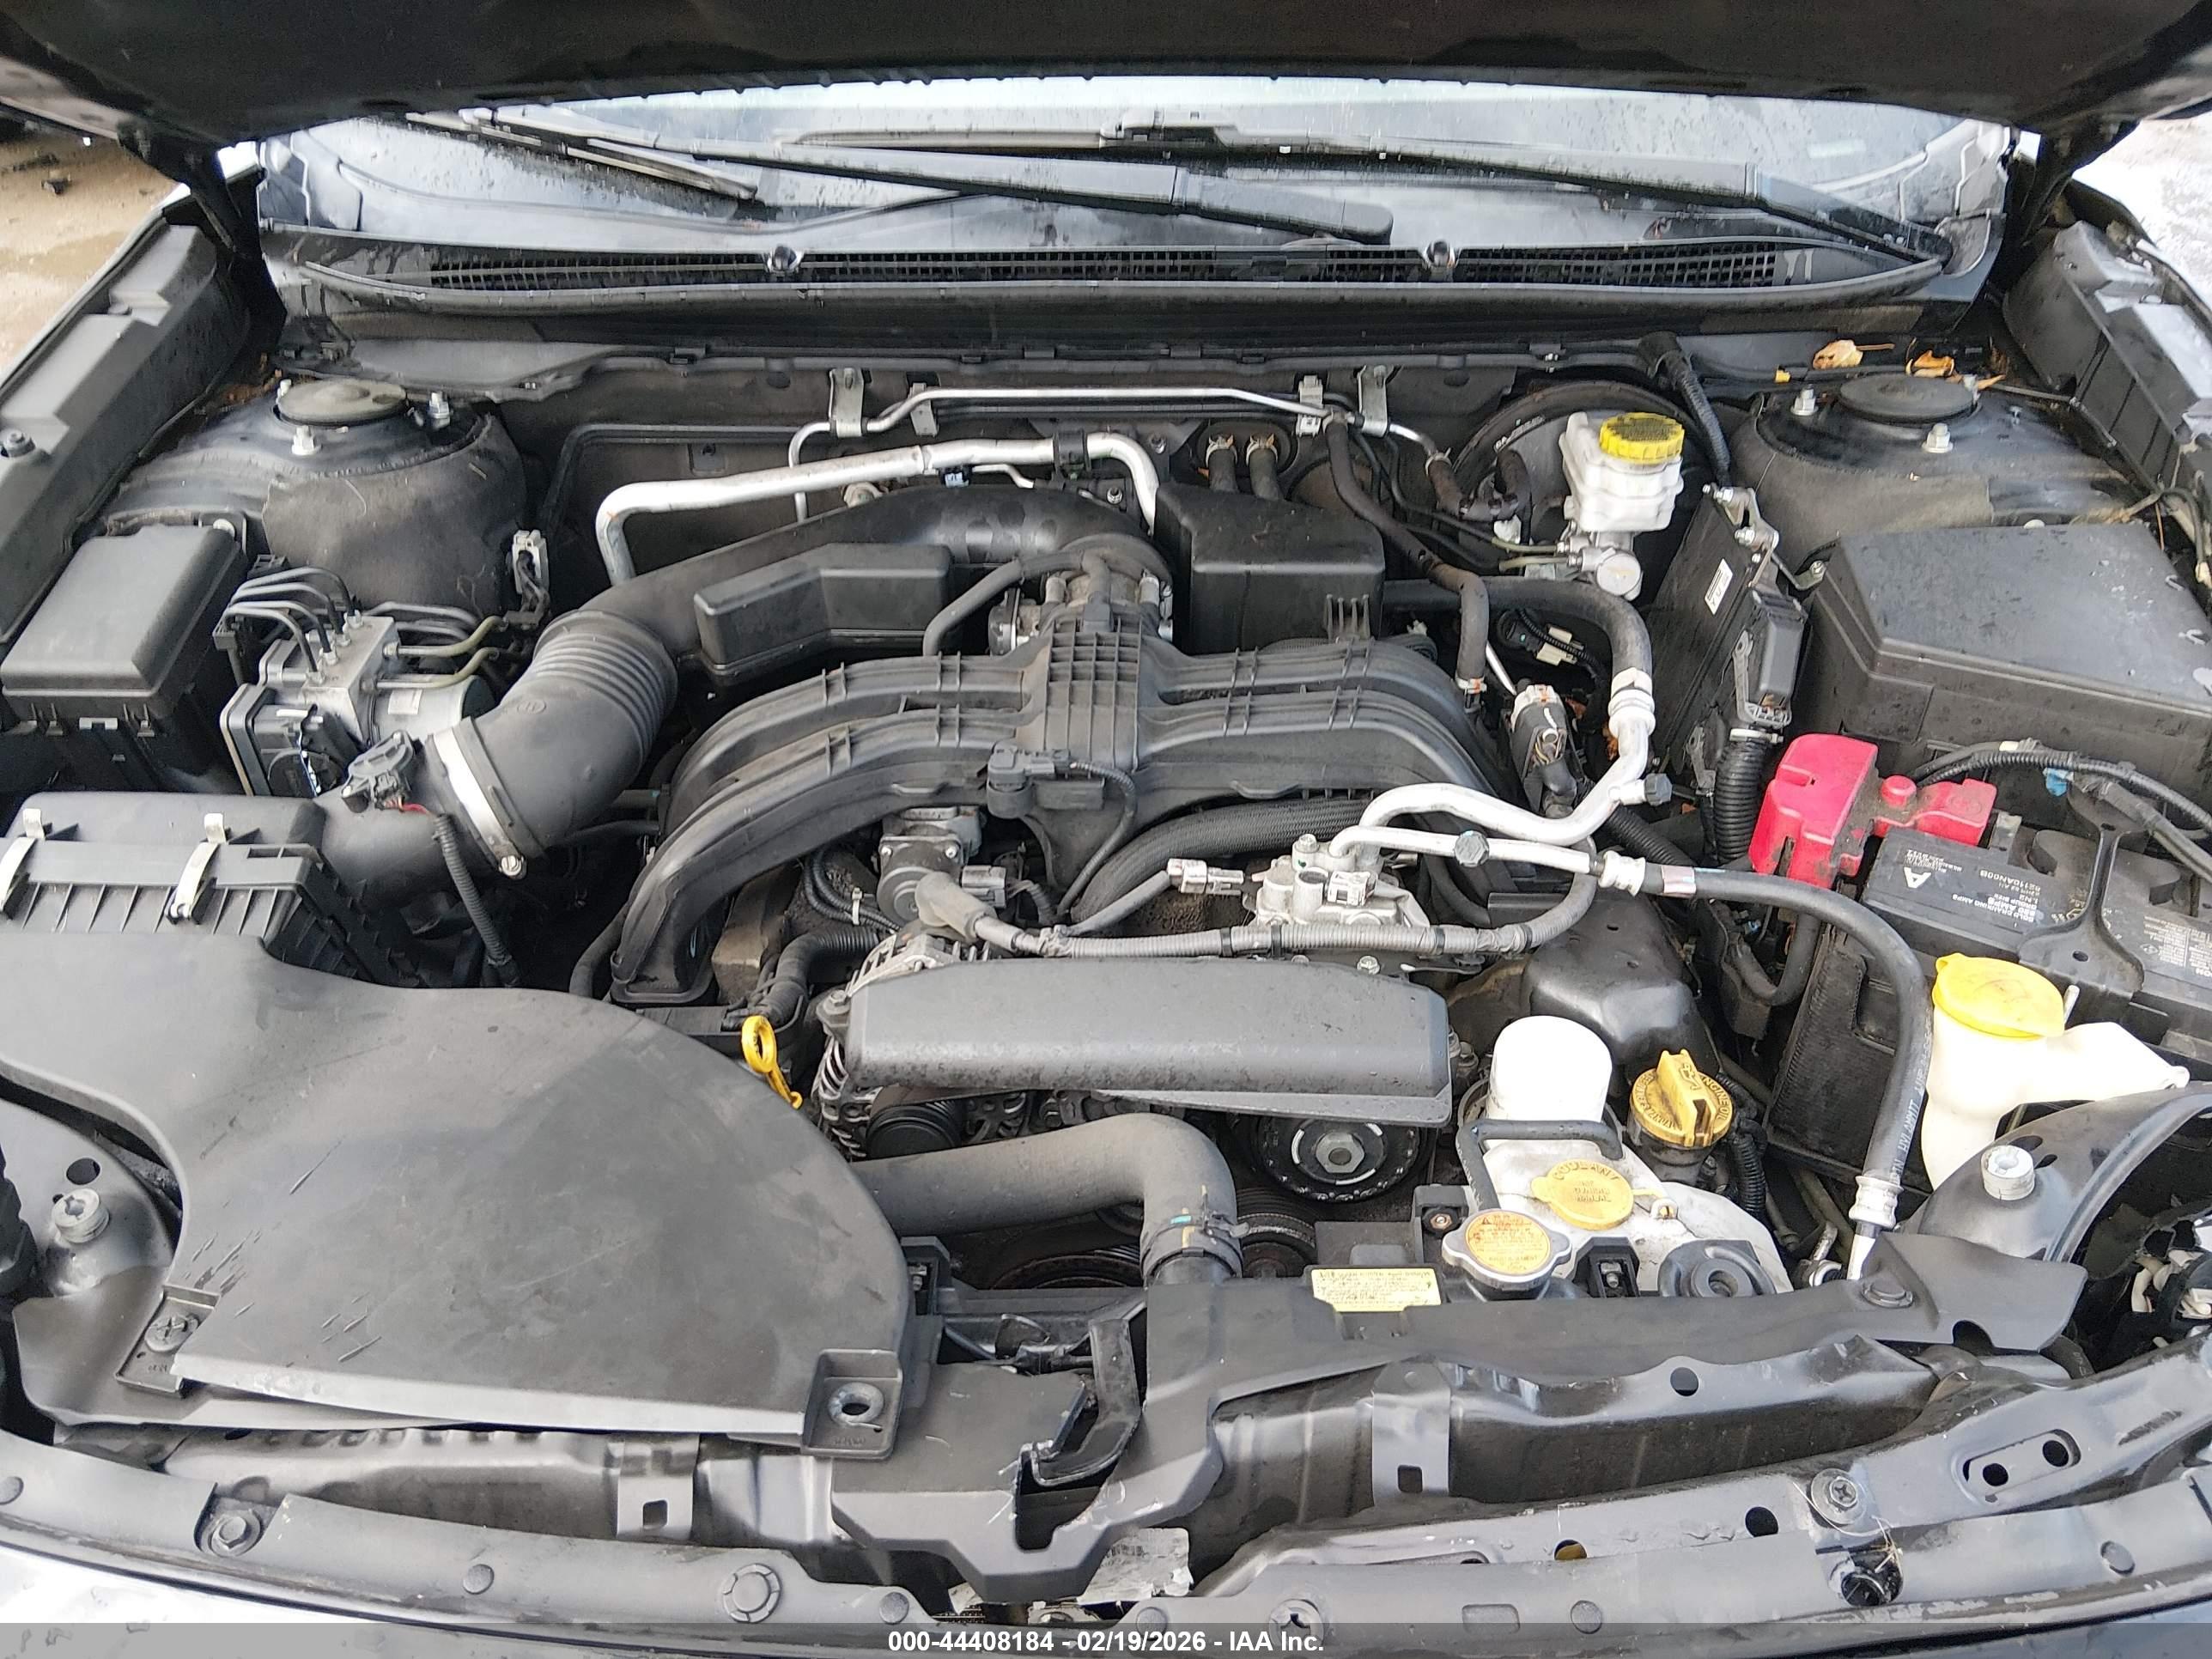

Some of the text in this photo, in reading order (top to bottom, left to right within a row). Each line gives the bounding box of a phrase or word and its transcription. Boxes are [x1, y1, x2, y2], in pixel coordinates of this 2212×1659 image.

[1952, 894, 1974, 904] AMPS
[1987, 896, 2016, 910] AMPS
[1717, 1108, 1729, 1121] OIL
